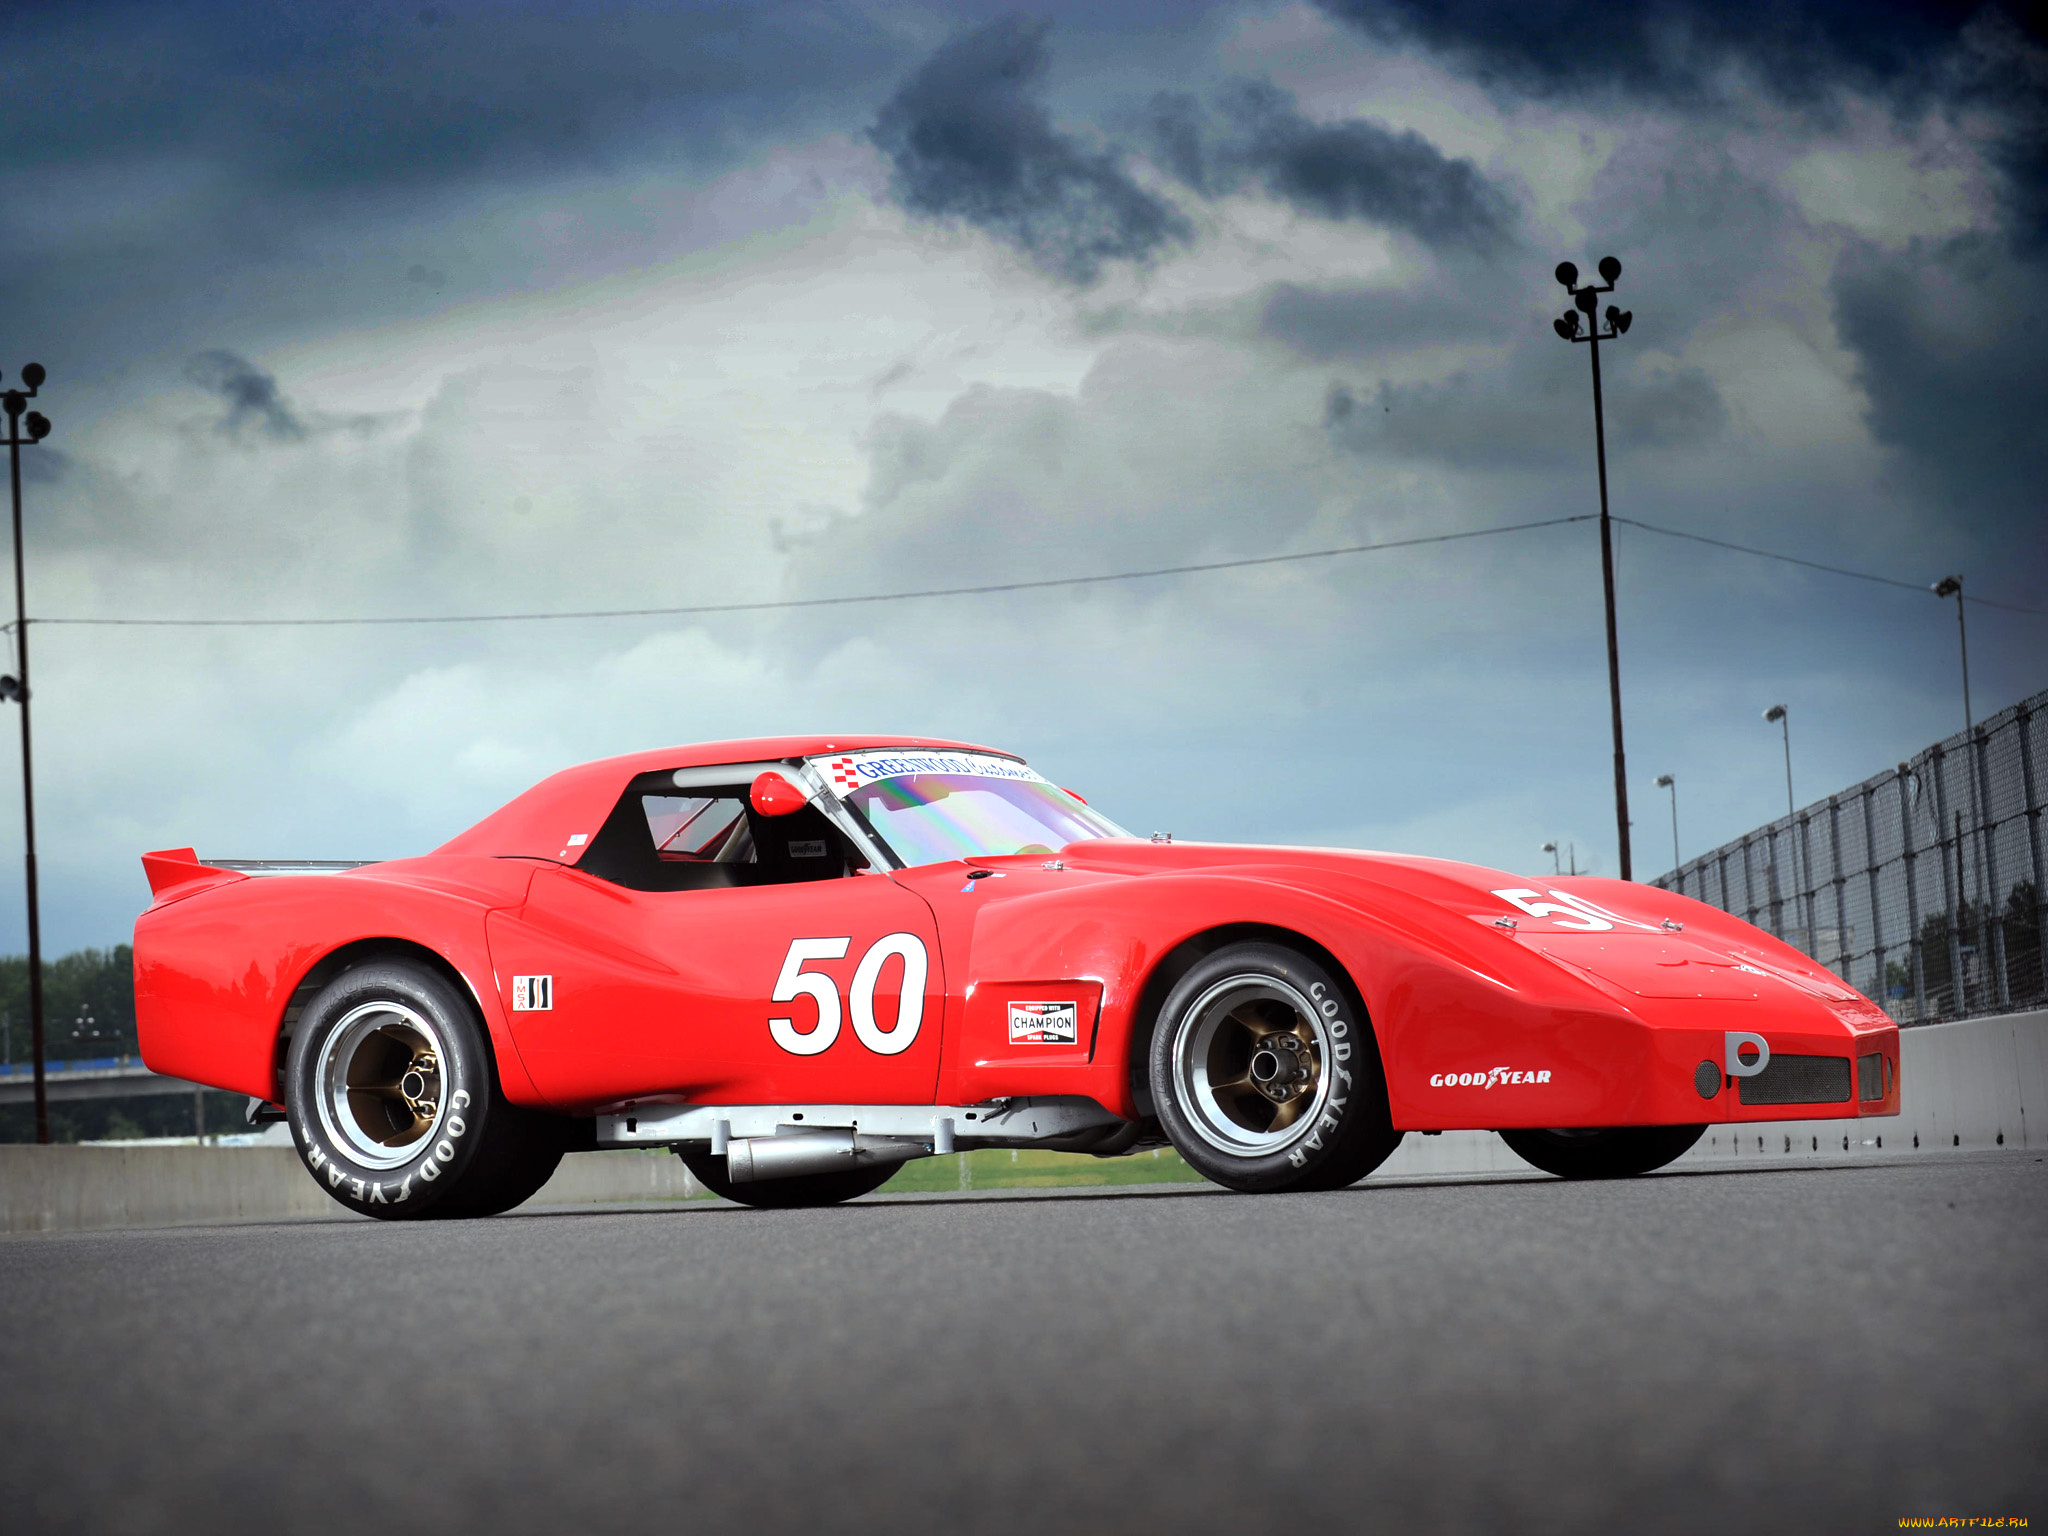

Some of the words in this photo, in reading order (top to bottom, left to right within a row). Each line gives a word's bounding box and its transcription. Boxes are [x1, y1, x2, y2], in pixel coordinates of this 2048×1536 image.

[856, 757, 972, 779] GREENWOOD
[516, 977, 526, 1009] IMSA
[768, 931, 929, 1057] 50
[1013, 1016, 1071, 1029] CHAMPION
[1290, 981, 1353, 1169] GOODYEAR
[1429, 1068, 1552, 1088] GOODYEAR
[307, 1088, 471, 1205] GOODYEAR
